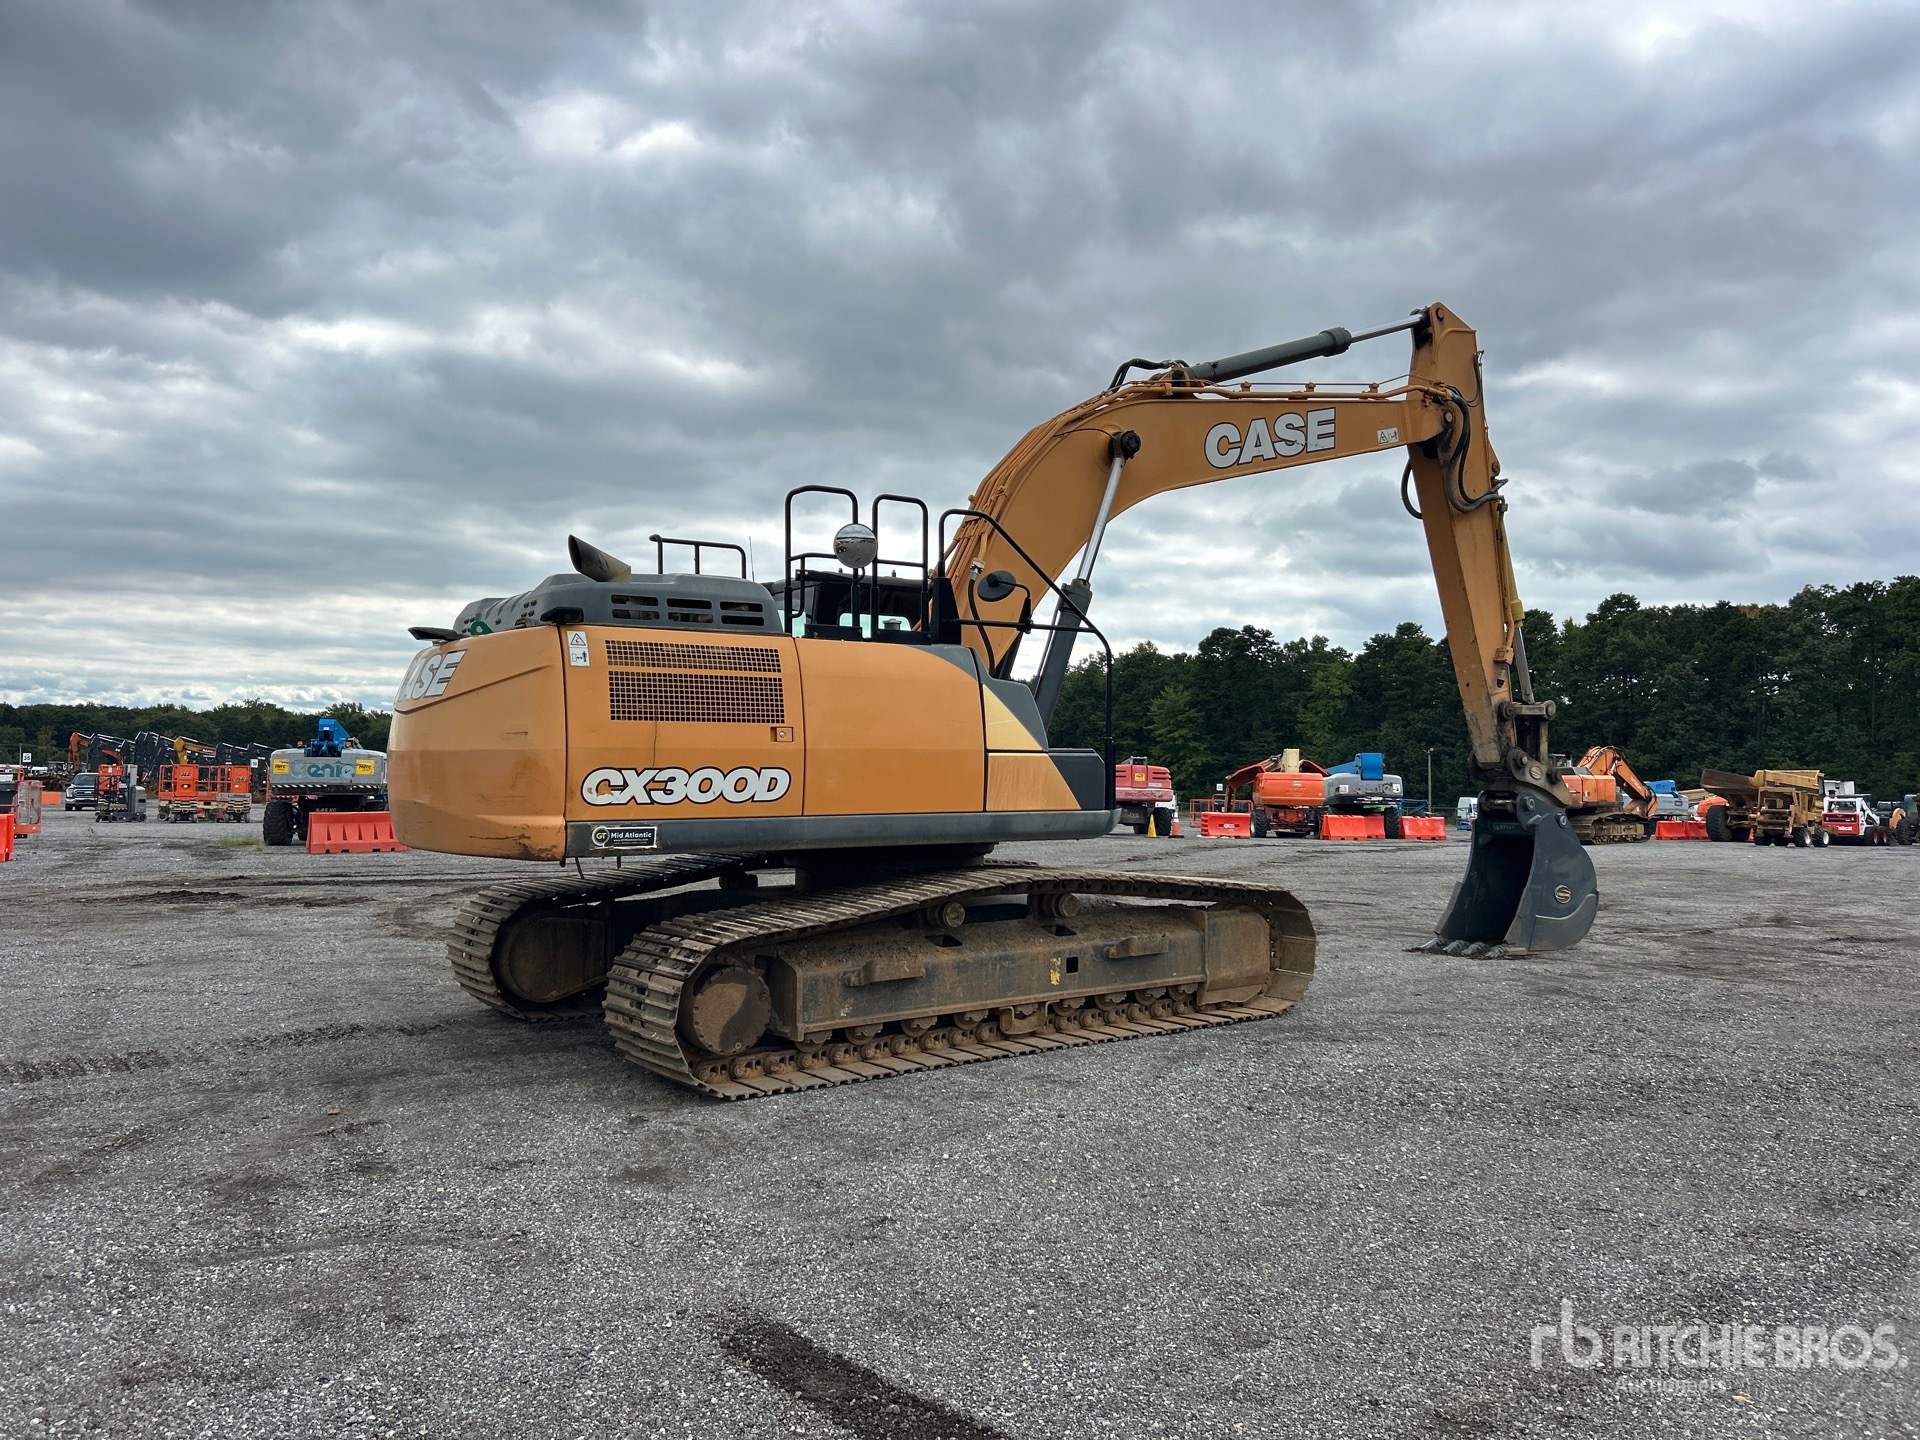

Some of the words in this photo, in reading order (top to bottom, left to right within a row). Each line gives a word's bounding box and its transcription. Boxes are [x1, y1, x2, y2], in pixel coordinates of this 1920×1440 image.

[1204, 407, 1336, 469] CASE
[398, 649, 468, 702] ASE
[290, 760, 354, 779] Genie
[581, 767, 790, 807] CX300D
[596, 832, 607, 840] GT
